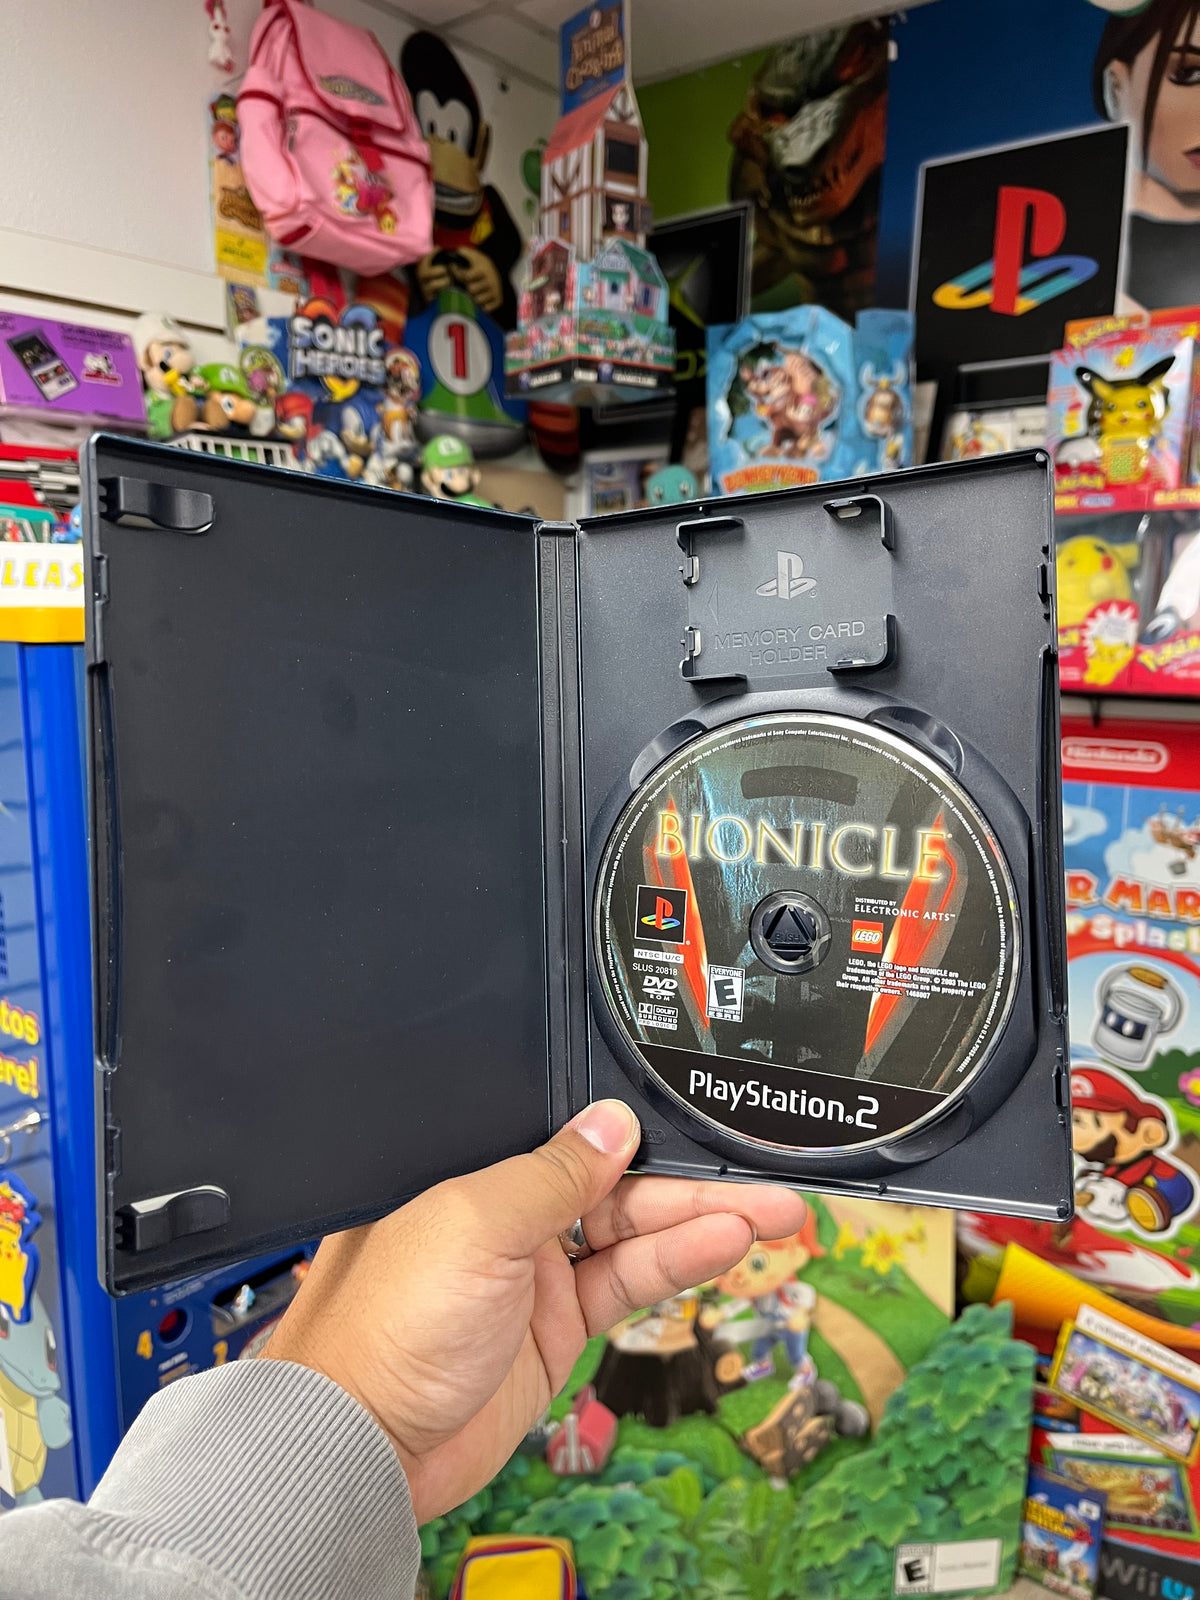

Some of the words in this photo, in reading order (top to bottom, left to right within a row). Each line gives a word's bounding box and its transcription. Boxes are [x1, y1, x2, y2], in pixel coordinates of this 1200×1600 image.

[293, 316, 384, 357] SONIC
[447, 323, 467, 378] 1
[295, 349, 385, 384] HEROES
[714, 626, 801, 650] MEMORY
[808, 620, 866, 641] CARD
[749, 644, 828, 666] HOLDER
[656, 811, 947, 880] BIONICLE
[854, 904, 919, 918] ELECTRONIC
[855, 897, 888, 905] DISTRIBUTED
[854, 930, 881, 943] LEGO
[632, 962, 654, 972] SLUS
[655, 965, 678, 975] 20818
[711, 966, 743, 977] EVERYONE
[846, 966, 878, 976] trademarks
[896, 972, 912, 981] LEGO
[912, 974, 933, 985] Group.
[941, 977, 956, 986] 2003
[957, 980, 969, 988] The
[969, 981, 987, 990] LEGO
[848, 958, 866, 967] LEGO,
[867, 960, 876, 968] the
[877, 961, 893, 970] LEGO
[894, 964, 907, 973] logo
[907, 965, 919, 973] and
[920, 966, 948, 977] BIONICLE
[643, 975, 678, 990] DVD
[714, 978, 738, 1007] E
[842, 974, 860, 983] Group.
[886, 979, 919, 989] trademarks
[931, 984, 941, 992] the
[942, 985, 967, 997] property
[967, 989, 974, 997] of
[850, 984, 879, 993] respective
[650, 994, 671, 1002] ROM
[638, 1013, 678, 1023] SURROUND
[903, 1559, 925, 1582] E
[1101, 1552, 1159, 1598] Wii
